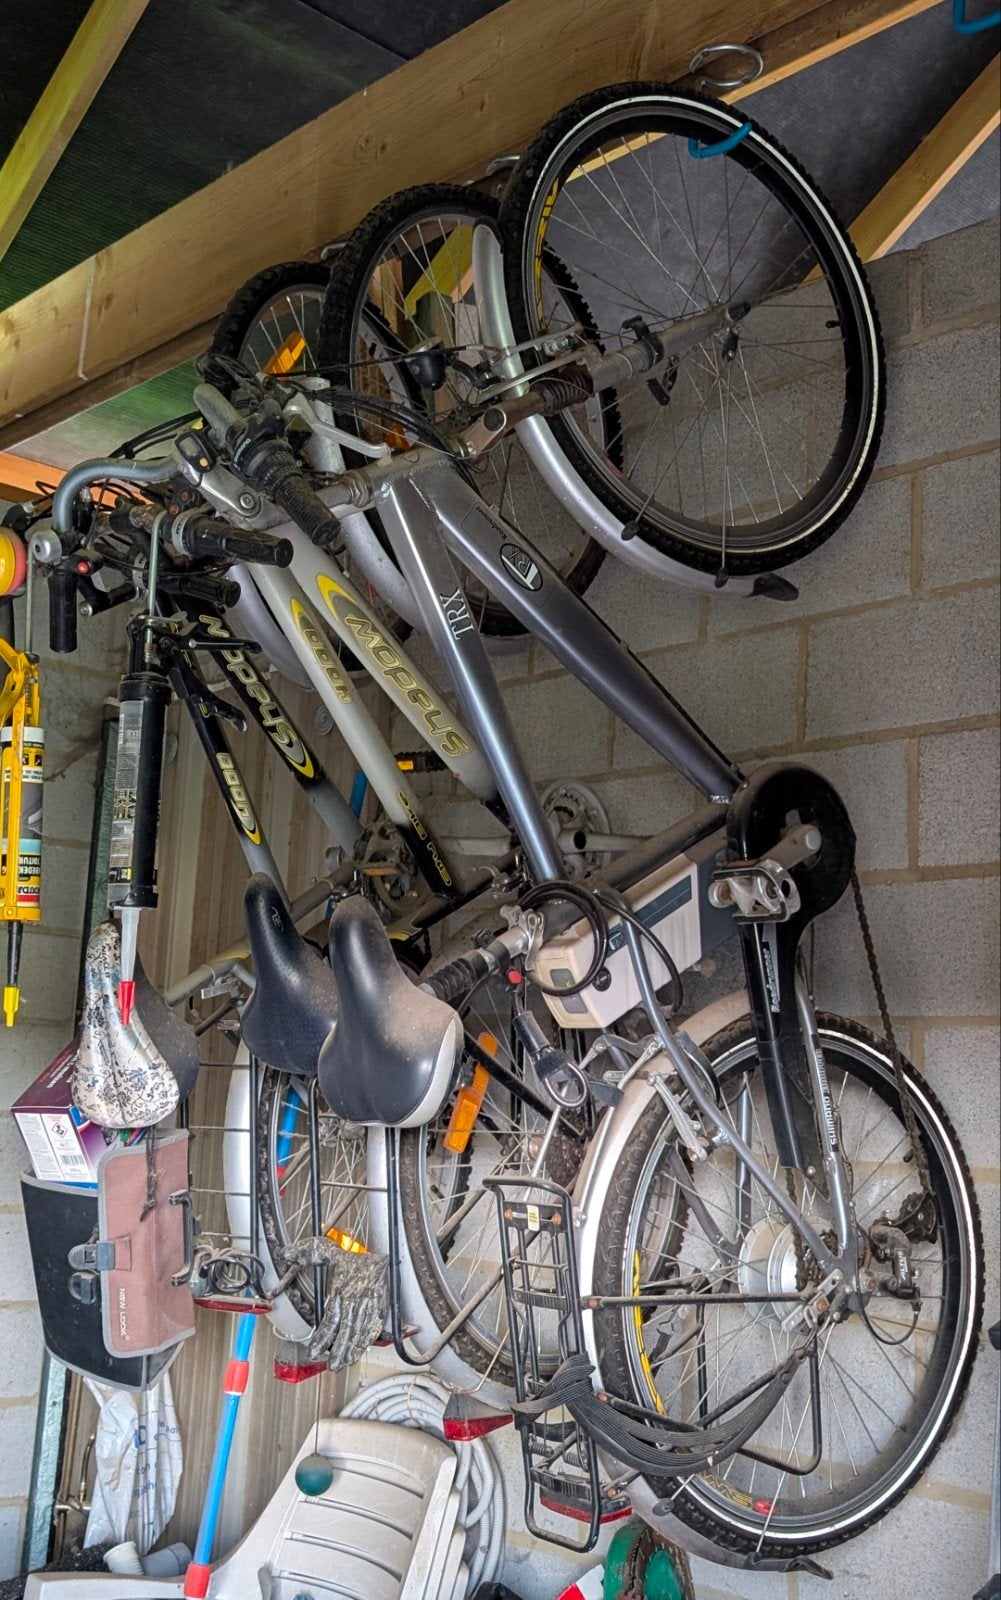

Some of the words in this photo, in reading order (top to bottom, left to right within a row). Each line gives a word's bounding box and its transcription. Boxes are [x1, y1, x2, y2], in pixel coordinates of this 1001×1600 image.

[440, 587, 475, 641] TRX
[303, 627, 352, 705] 4000
[824, 1096, 838, 1146] SHIMANO
